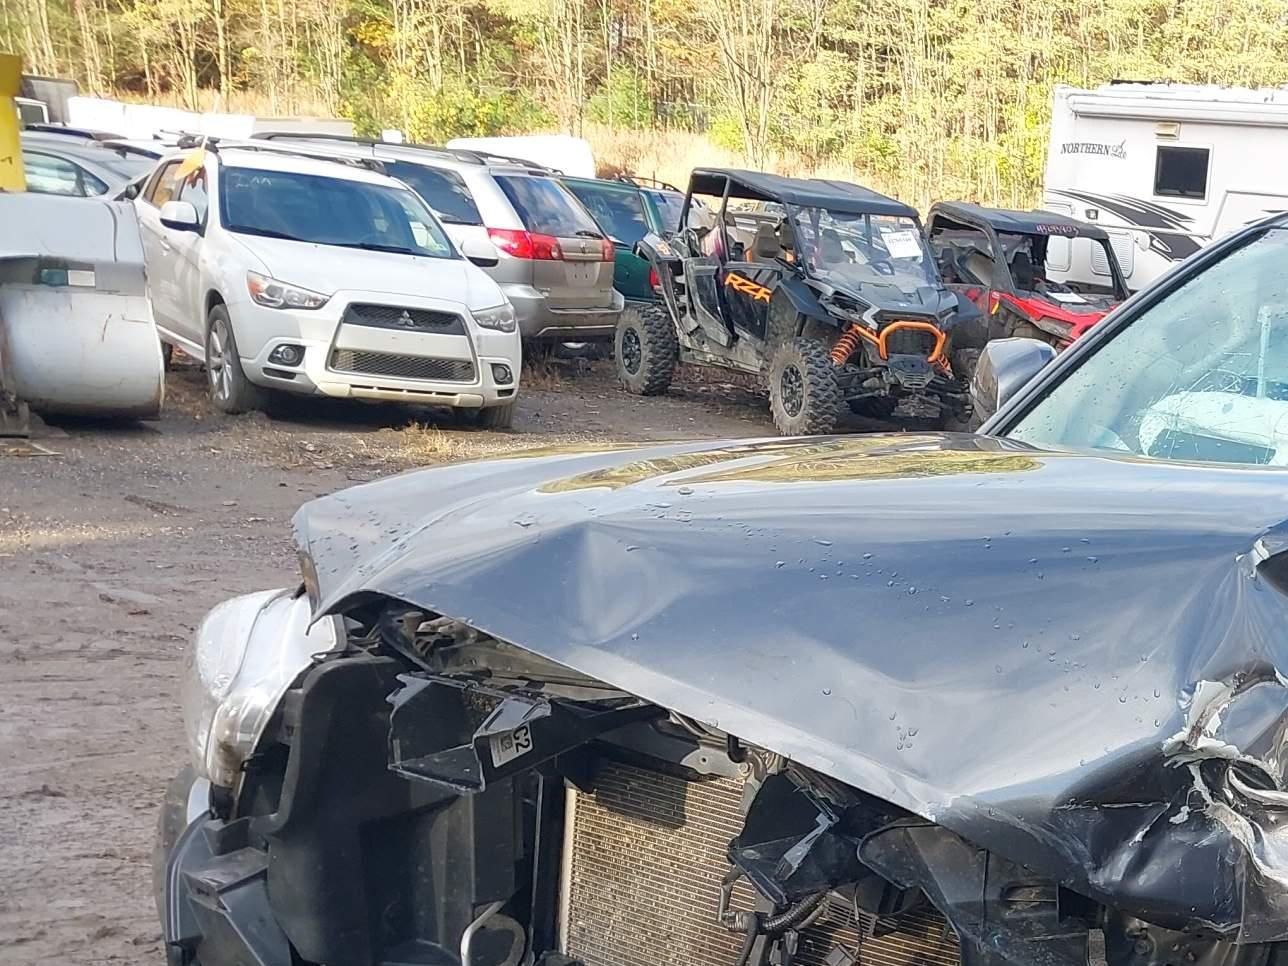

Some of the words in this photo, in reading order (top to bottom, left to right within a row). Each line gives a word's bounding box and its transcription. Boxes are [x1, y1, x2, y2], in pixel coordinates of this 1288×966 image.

[1060, 142, 1111, 156] NORTHERN
[724, 272, 773, 304] RZR
[513, 726, 531, 753] C2
